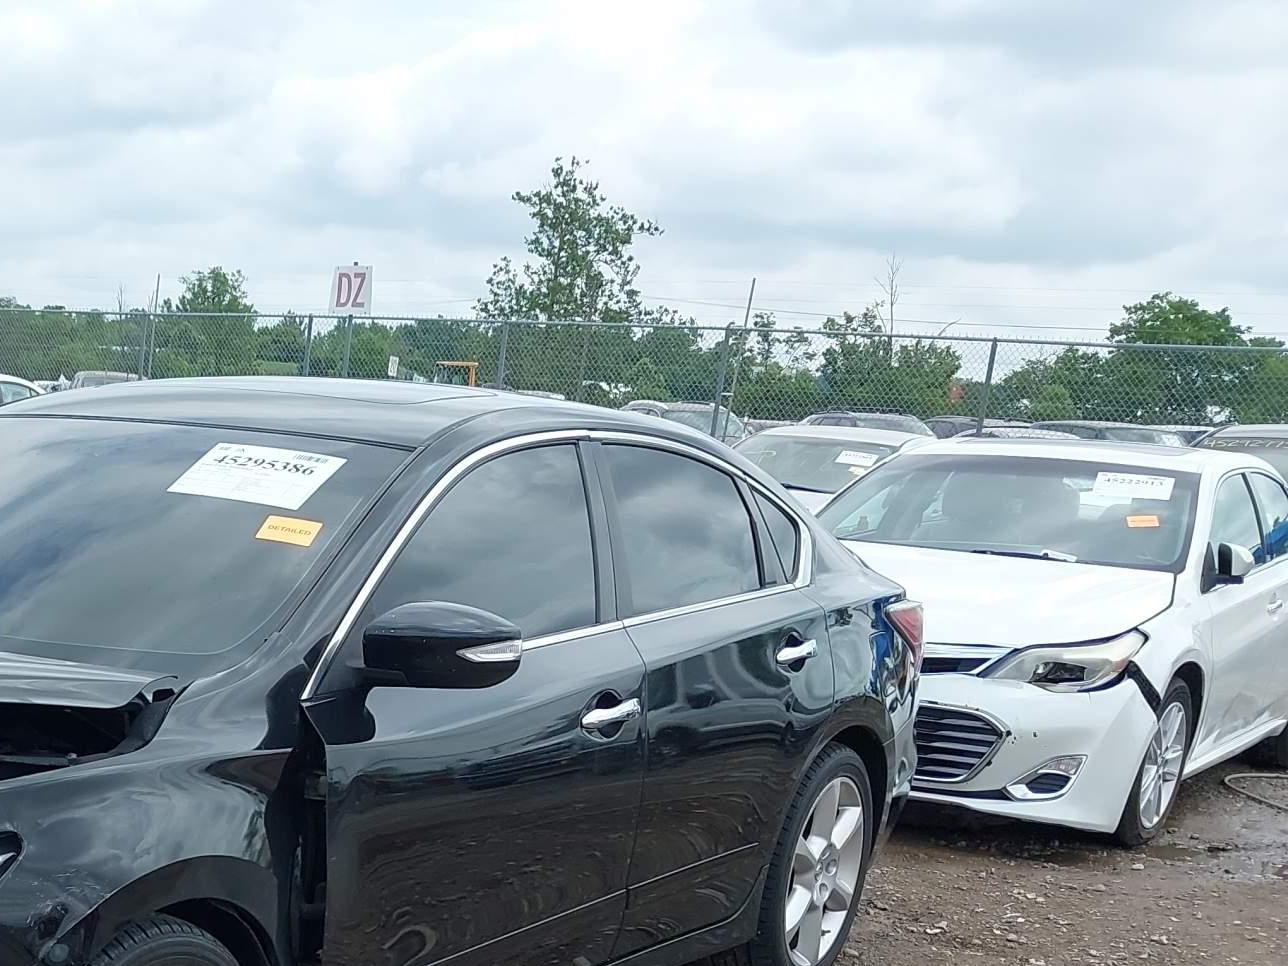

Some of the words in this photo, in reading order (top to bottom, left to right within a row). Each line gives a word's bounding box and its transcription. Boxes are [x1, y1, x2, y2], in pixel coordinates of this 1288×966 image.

[335, 272, 366, 308] DZ
[213, 454, 318, 476] 45295386
[268, 525, 312, 537] DETAILED
